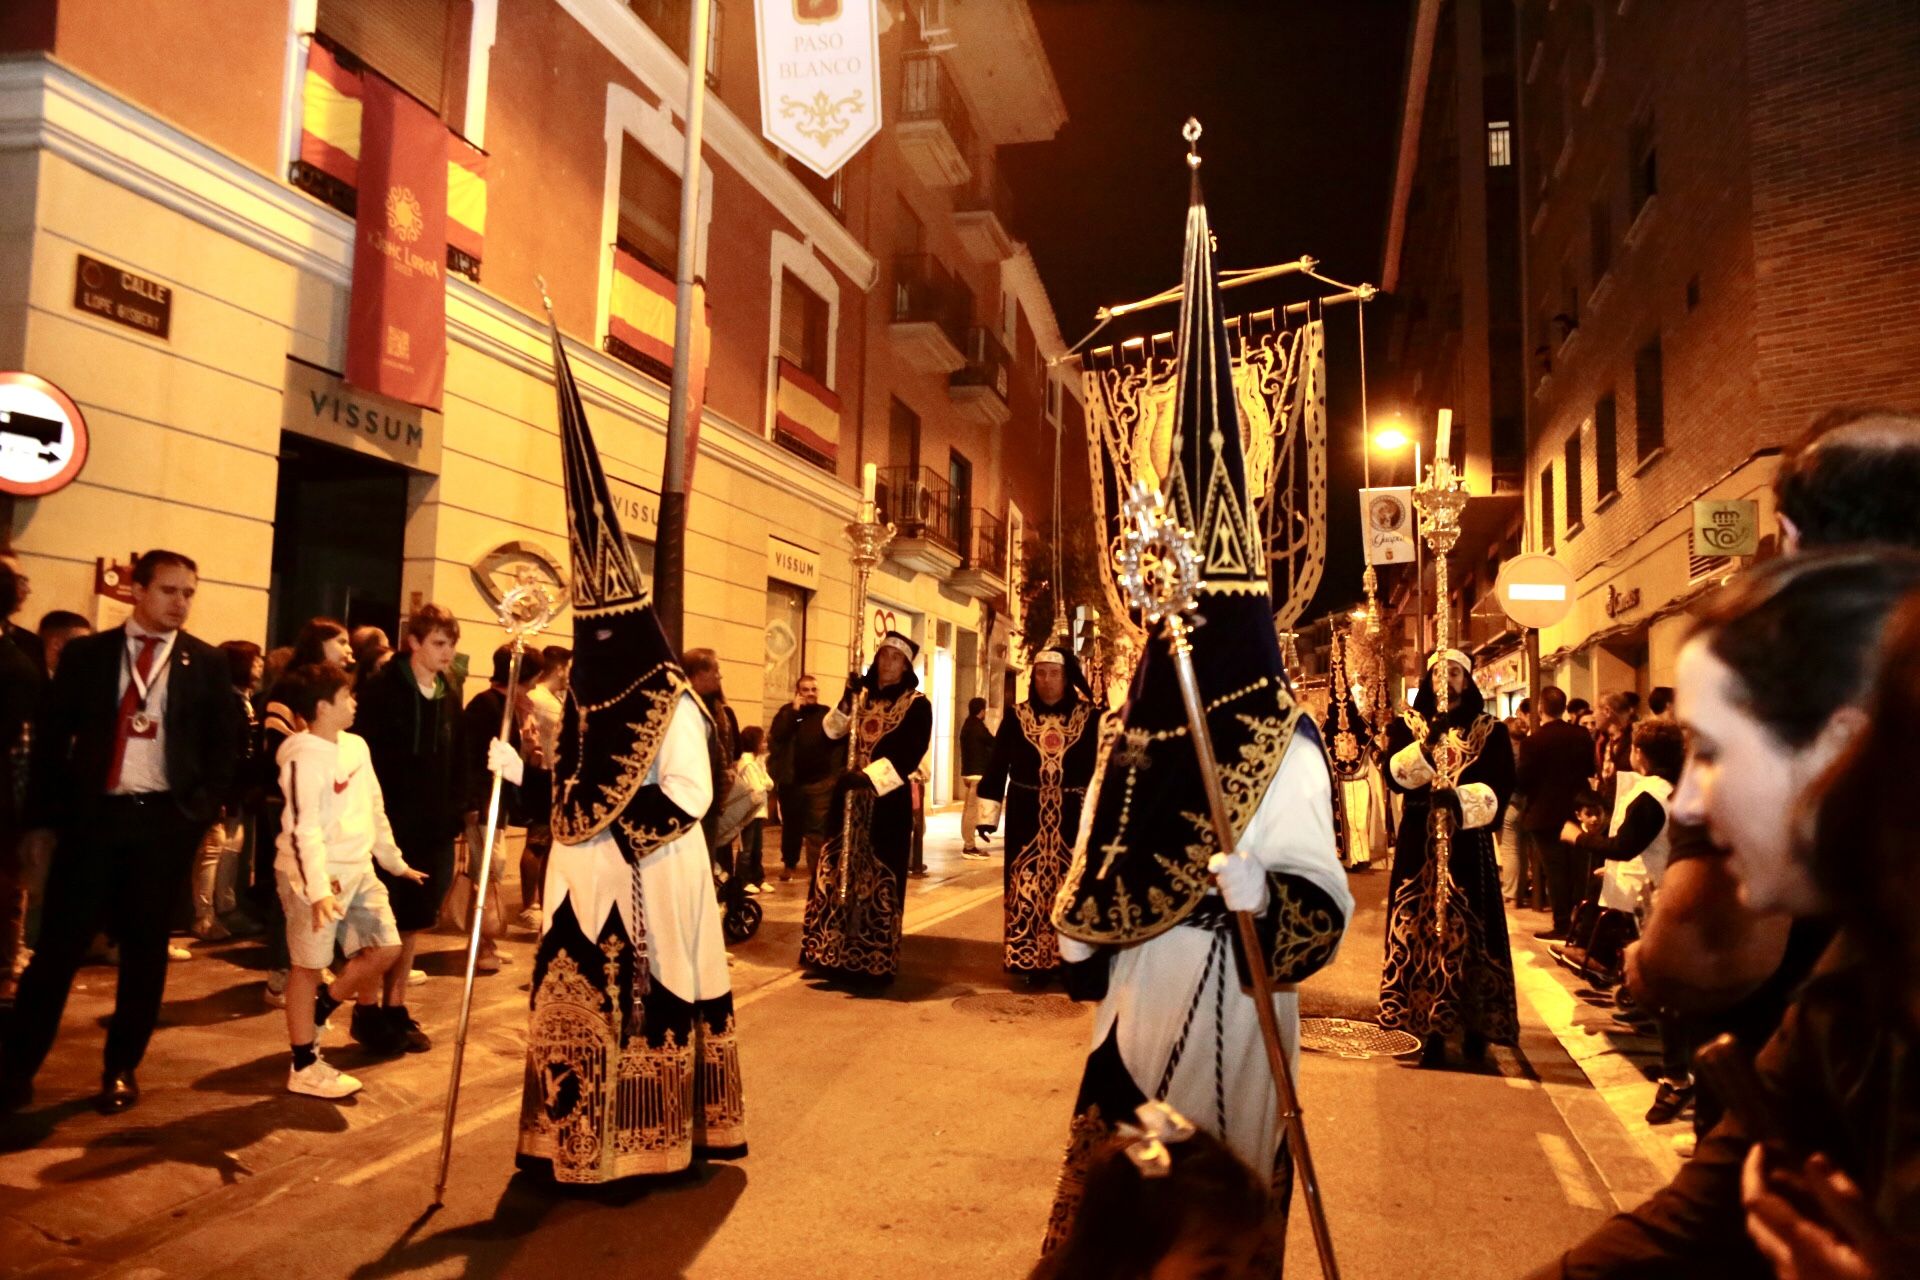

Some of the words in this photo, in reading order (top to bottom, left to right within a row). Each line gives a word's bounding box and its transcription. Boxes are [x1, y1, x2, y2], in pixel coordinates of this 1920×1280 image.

[793, 32, 844, 52] PASO
[779, 57, 862, 80] BLANCO
[121, 272, 167, 304] CALLE
[83, 291, 114, 315] LOPE
[310, 390, 423, 448] VISSUM
[775, 551, 814, 577] VISSUM
